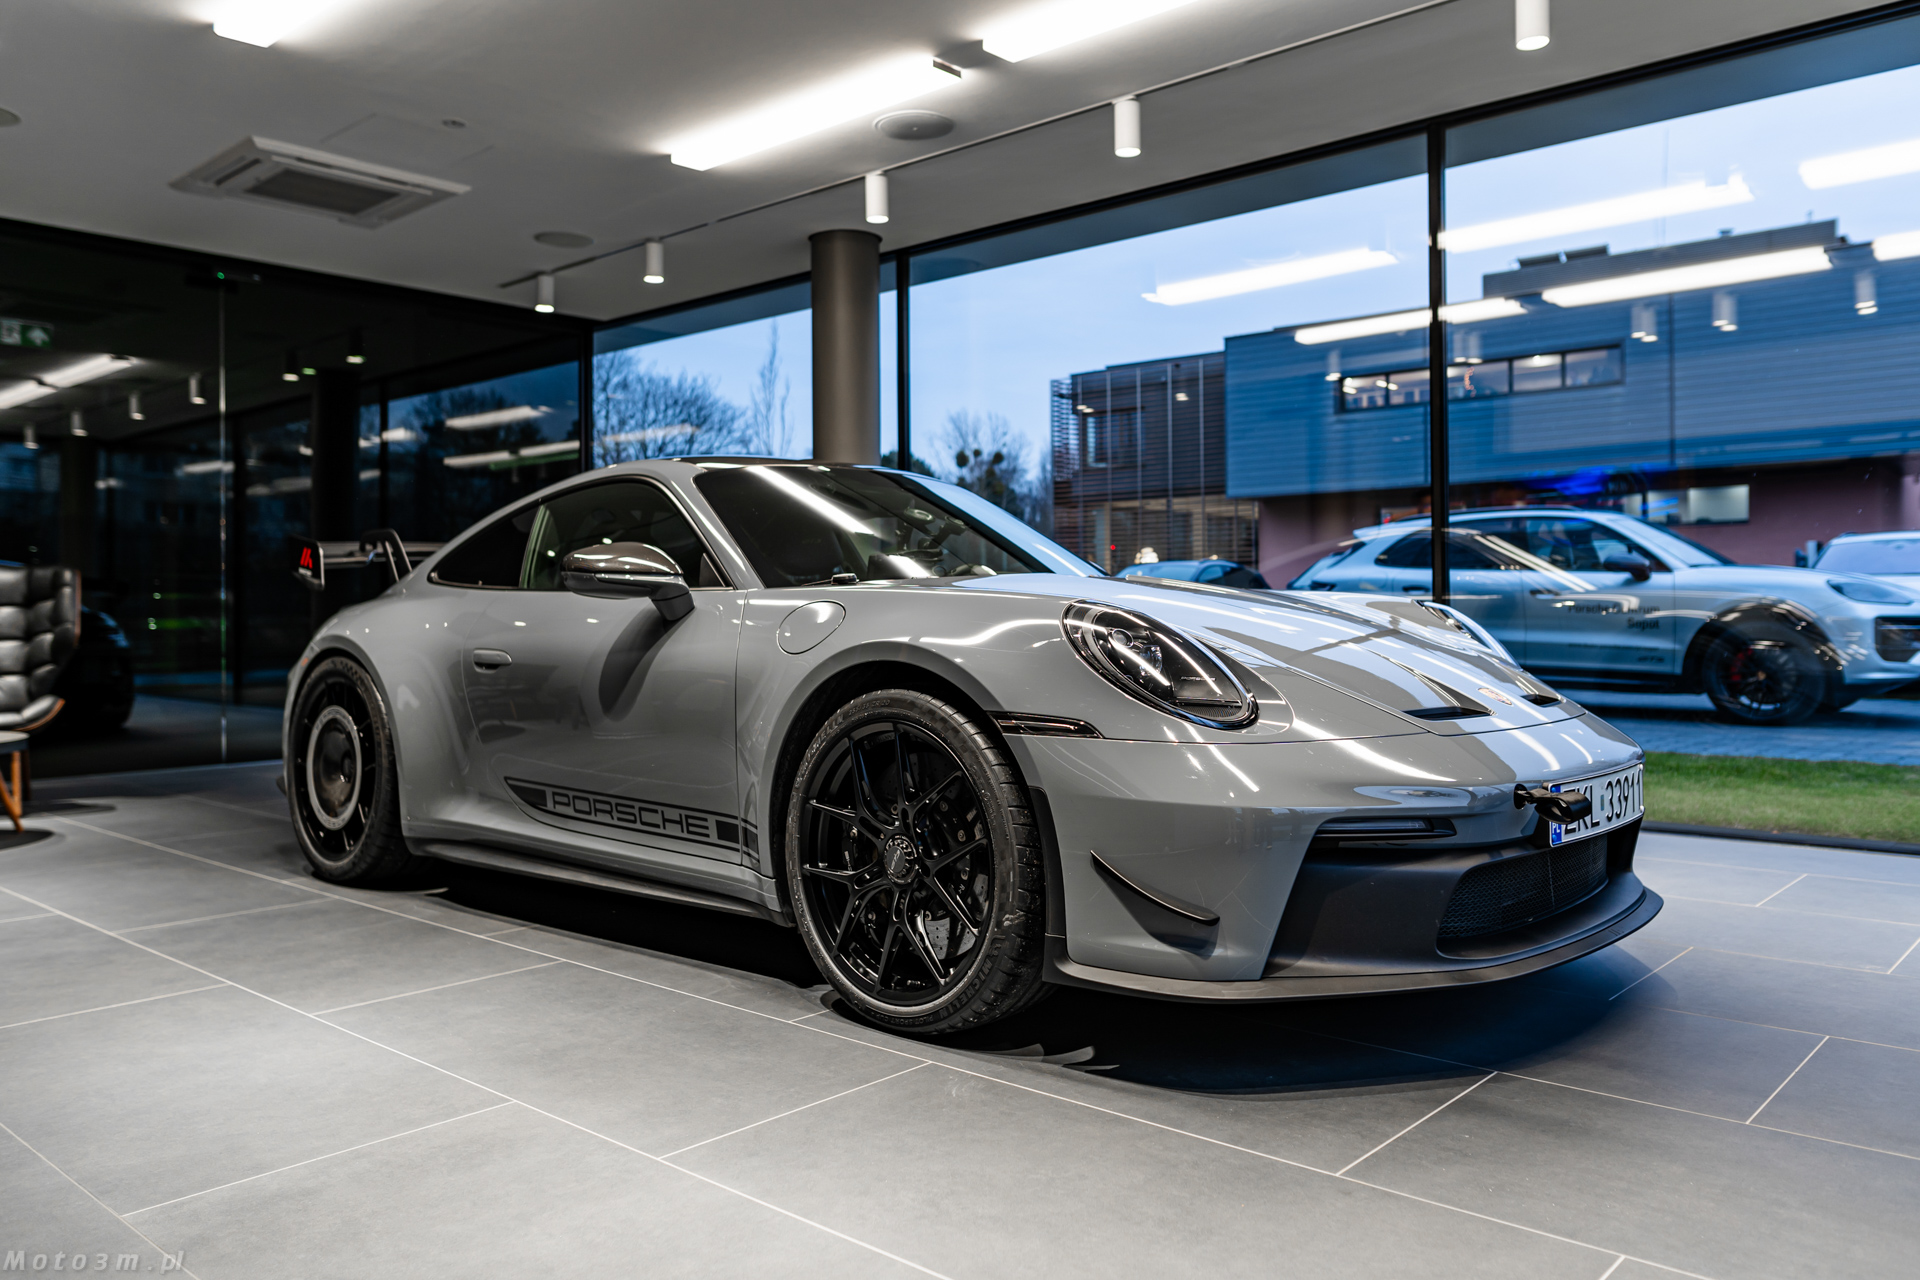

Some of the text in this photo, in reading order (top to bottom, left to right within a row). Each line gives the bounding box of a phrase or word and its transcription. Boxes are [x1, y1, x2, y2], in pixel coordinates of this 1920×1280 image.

[1613, 603, 1660, 616] Ctrum
[1627, 617, 1659, 632] Sopot
[1605, 768, 1641, 822] 33911
[552, 791, 711, 839] PORSCHE
[1552, 822, 1561, 834] PL
[938, 958, 993, 1019] MICHELIN
[890, 1017, 913, 1026] SPORT
